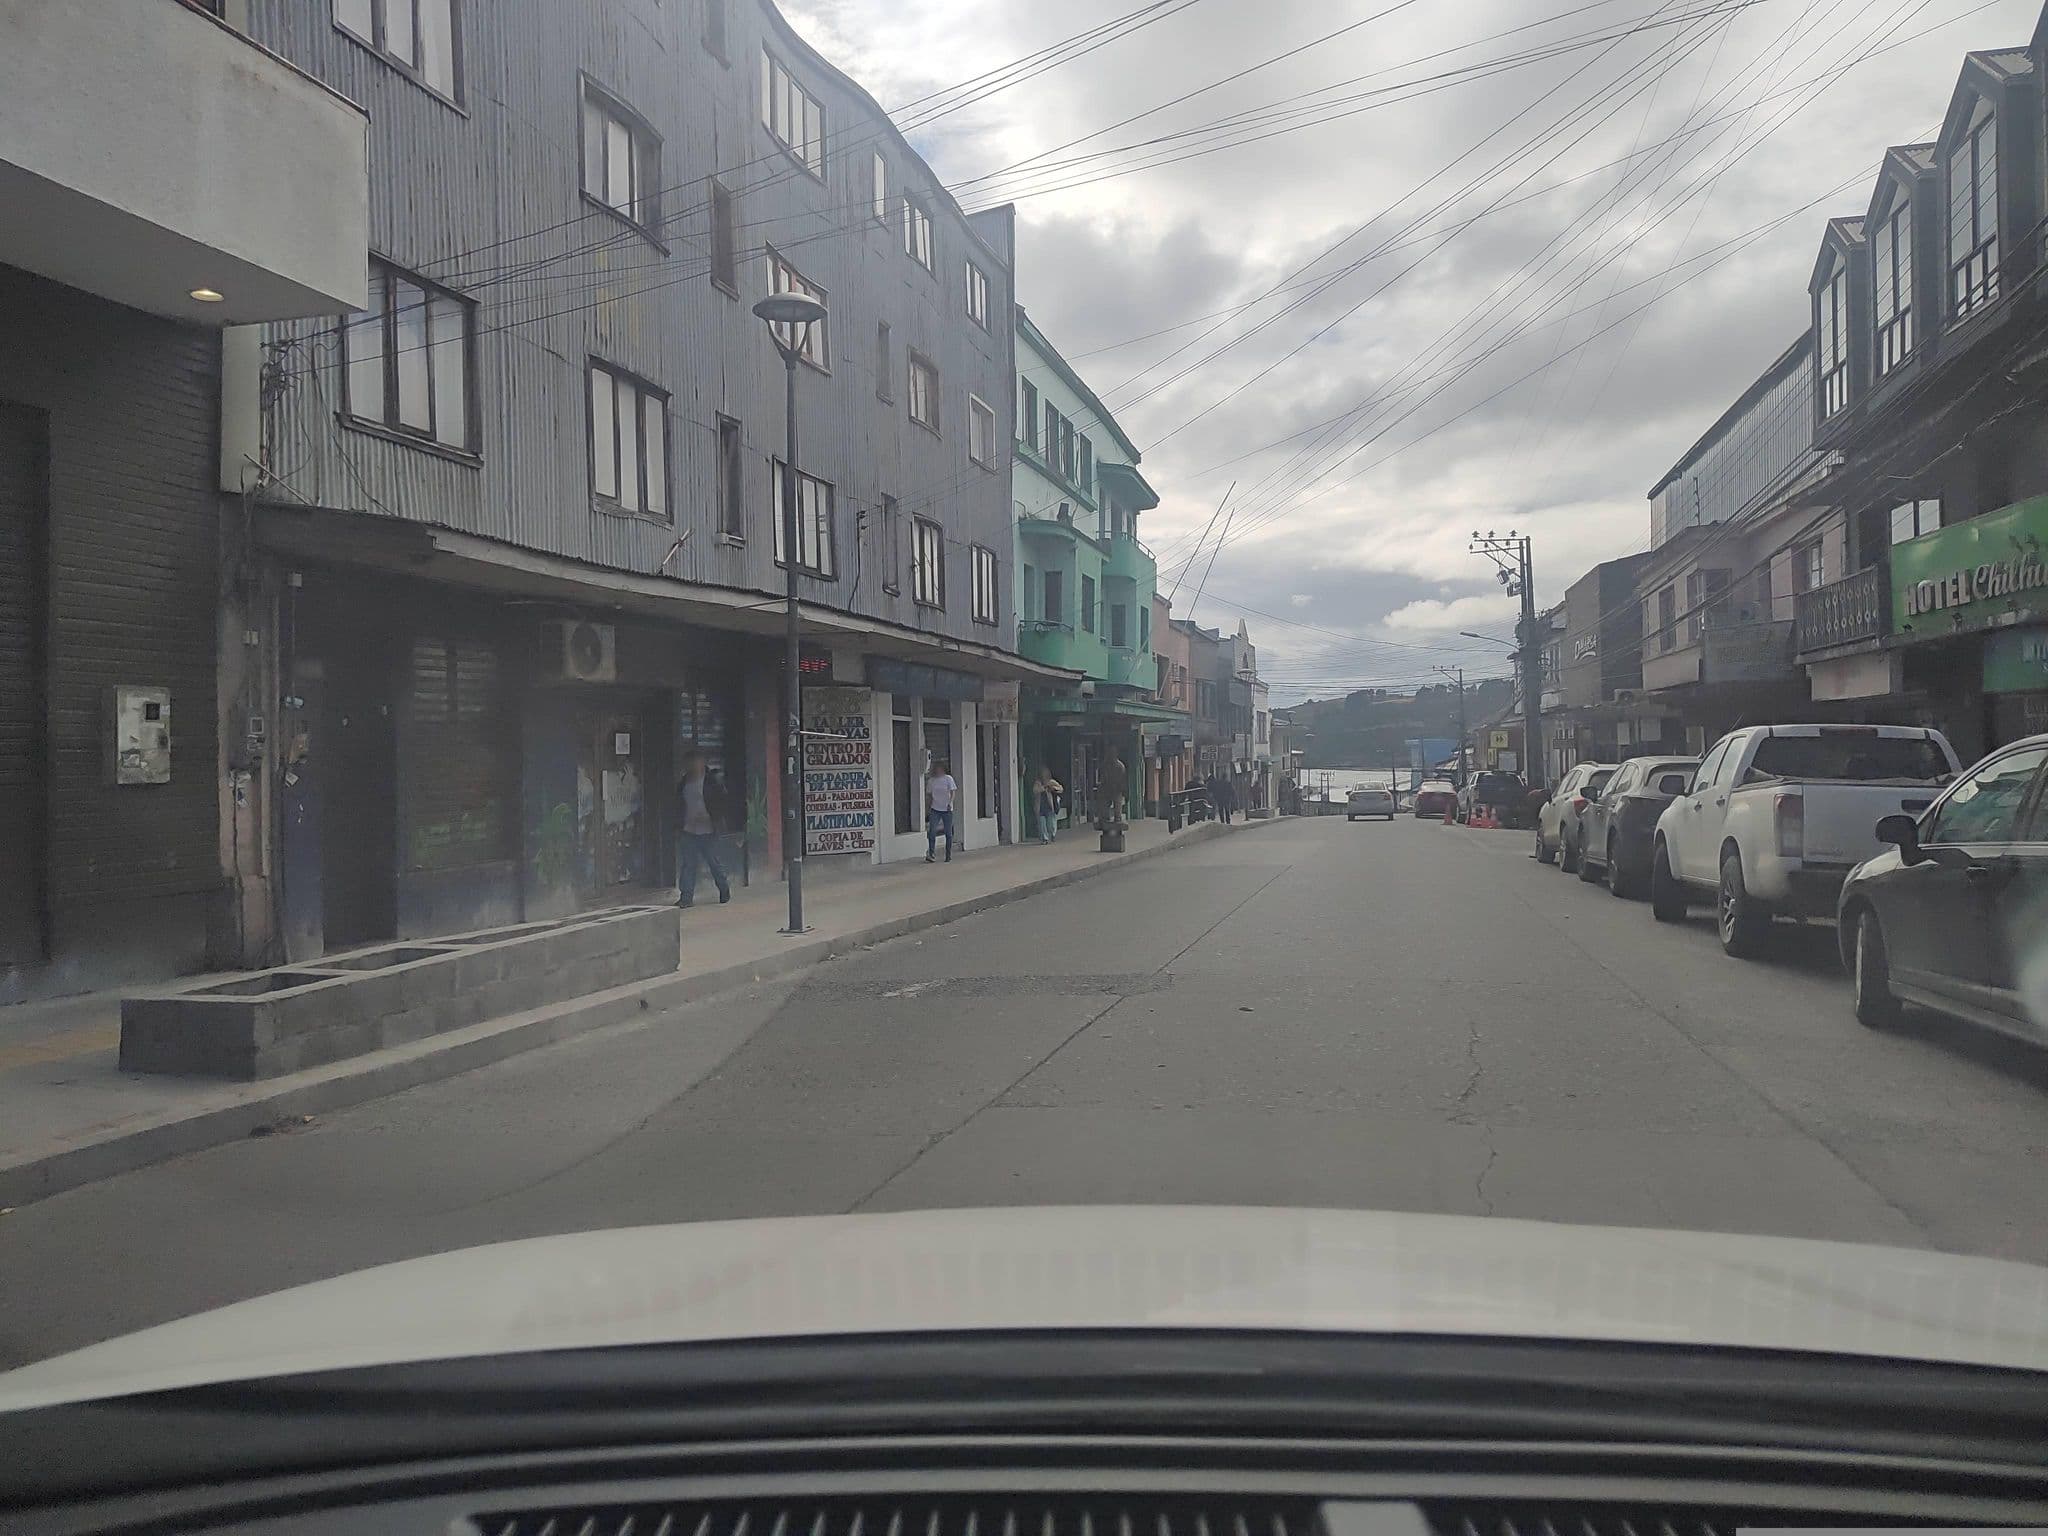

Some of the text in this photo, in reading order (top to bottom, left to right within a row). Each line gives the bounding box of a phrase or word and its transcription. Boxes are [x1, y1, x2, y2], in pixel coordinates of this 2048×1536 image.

[1904, 568, 1970, 617] HOTEL
[812, 716, 865, 728] TALER
[805, 742, 872, 754] CENTRO DE
[807, 754, 870, 766] GRABADOS
[805, 772, 873, 784] SOLDADURA
[827, 780, 868, 791] LENTES
[806, 793, 827, 803] PILAS
[832, 791, 873, 802] PASADORES
[841, 800, 874, 811] PULSERAS
[806, 812, 874, 830] PLASTIFICADOS
[819, 831, 864, 842] COPIA DE
[807, 840, 844, 852] LLAVES
[851, 839, 874, 849] CHIP
